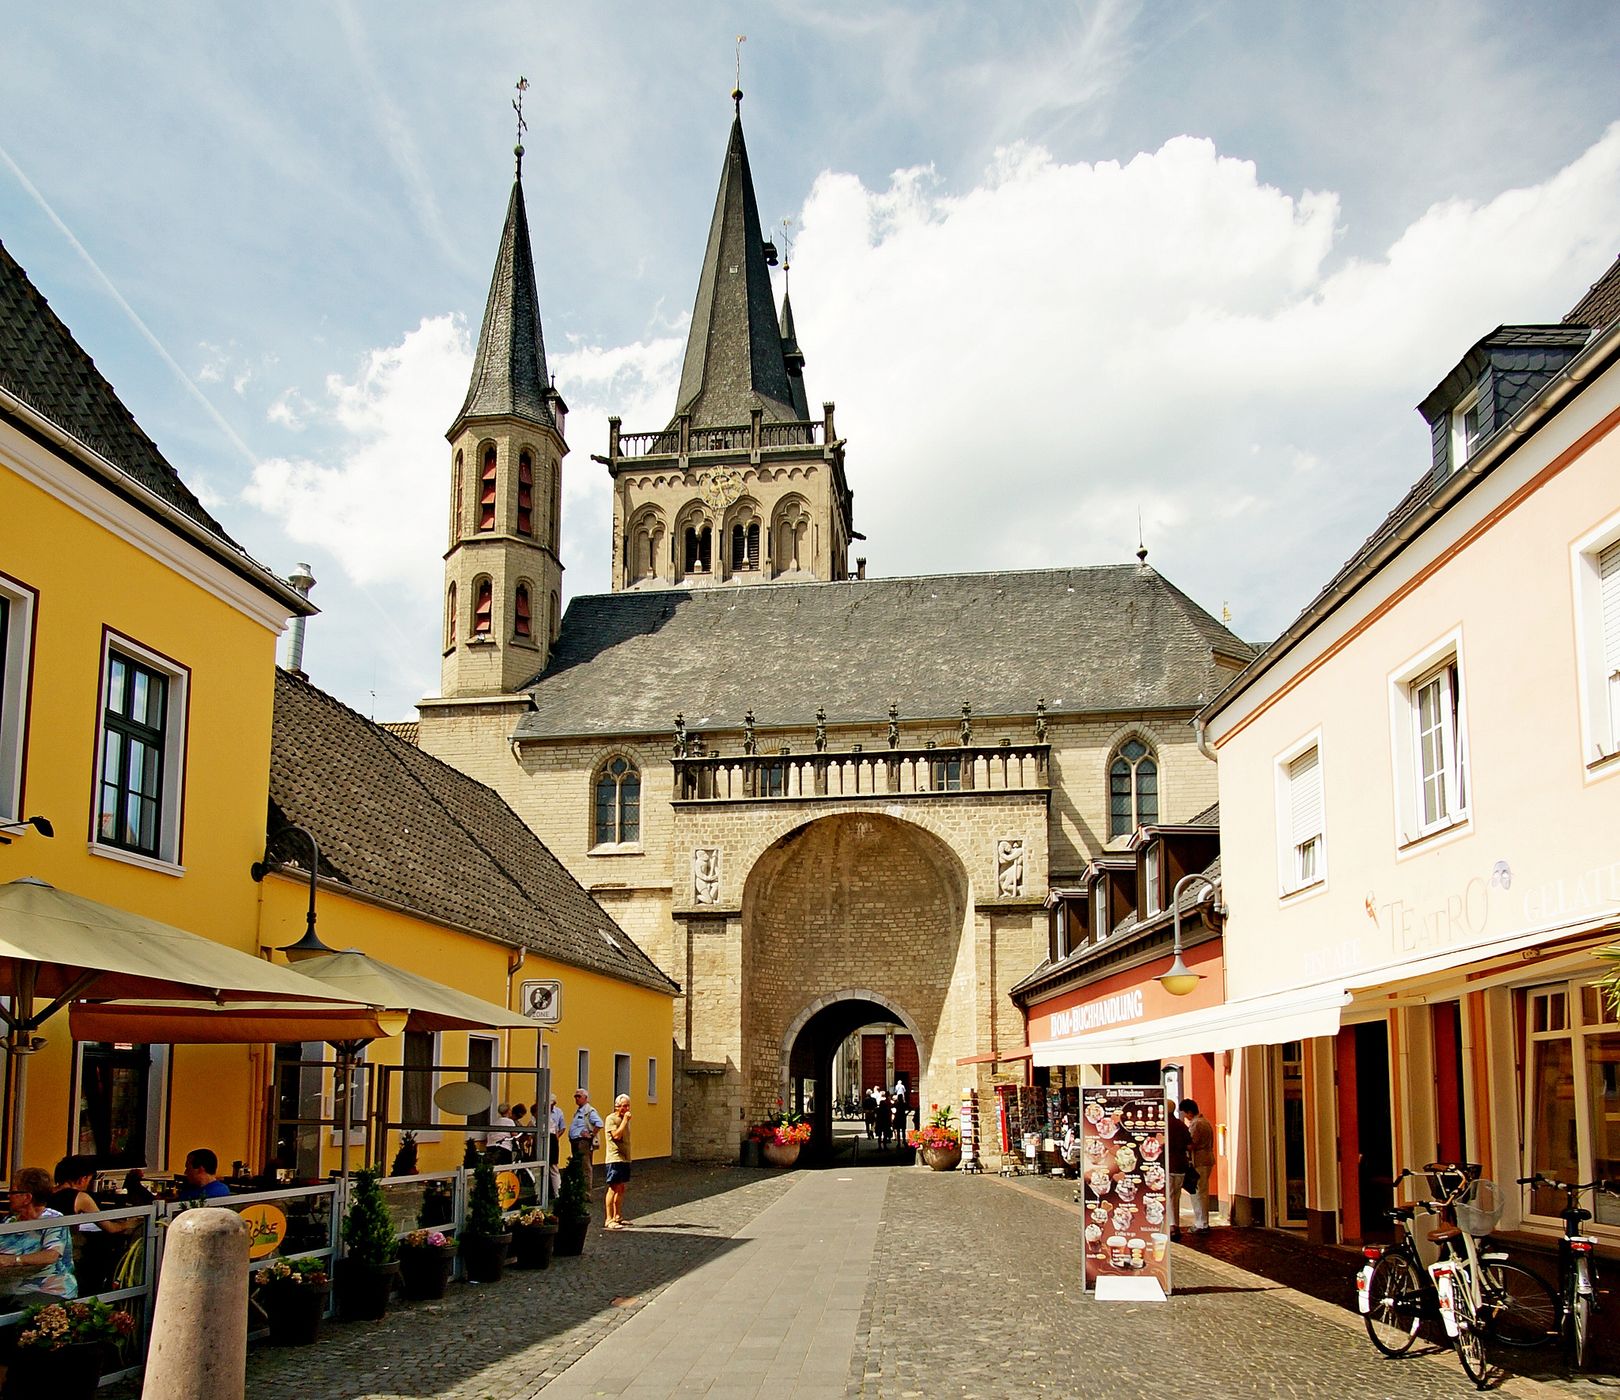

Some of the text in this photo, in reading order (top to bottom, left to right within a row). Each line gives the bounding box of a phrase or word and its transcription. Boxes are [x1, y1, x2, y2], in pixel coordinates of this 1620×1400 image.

[1381, 877, 1489, 953] TEATRO
[532, 1010, 550, 1018] ZONE
[1050, 990, 1143, 1038] DOM-BUCHHANDLUNG
